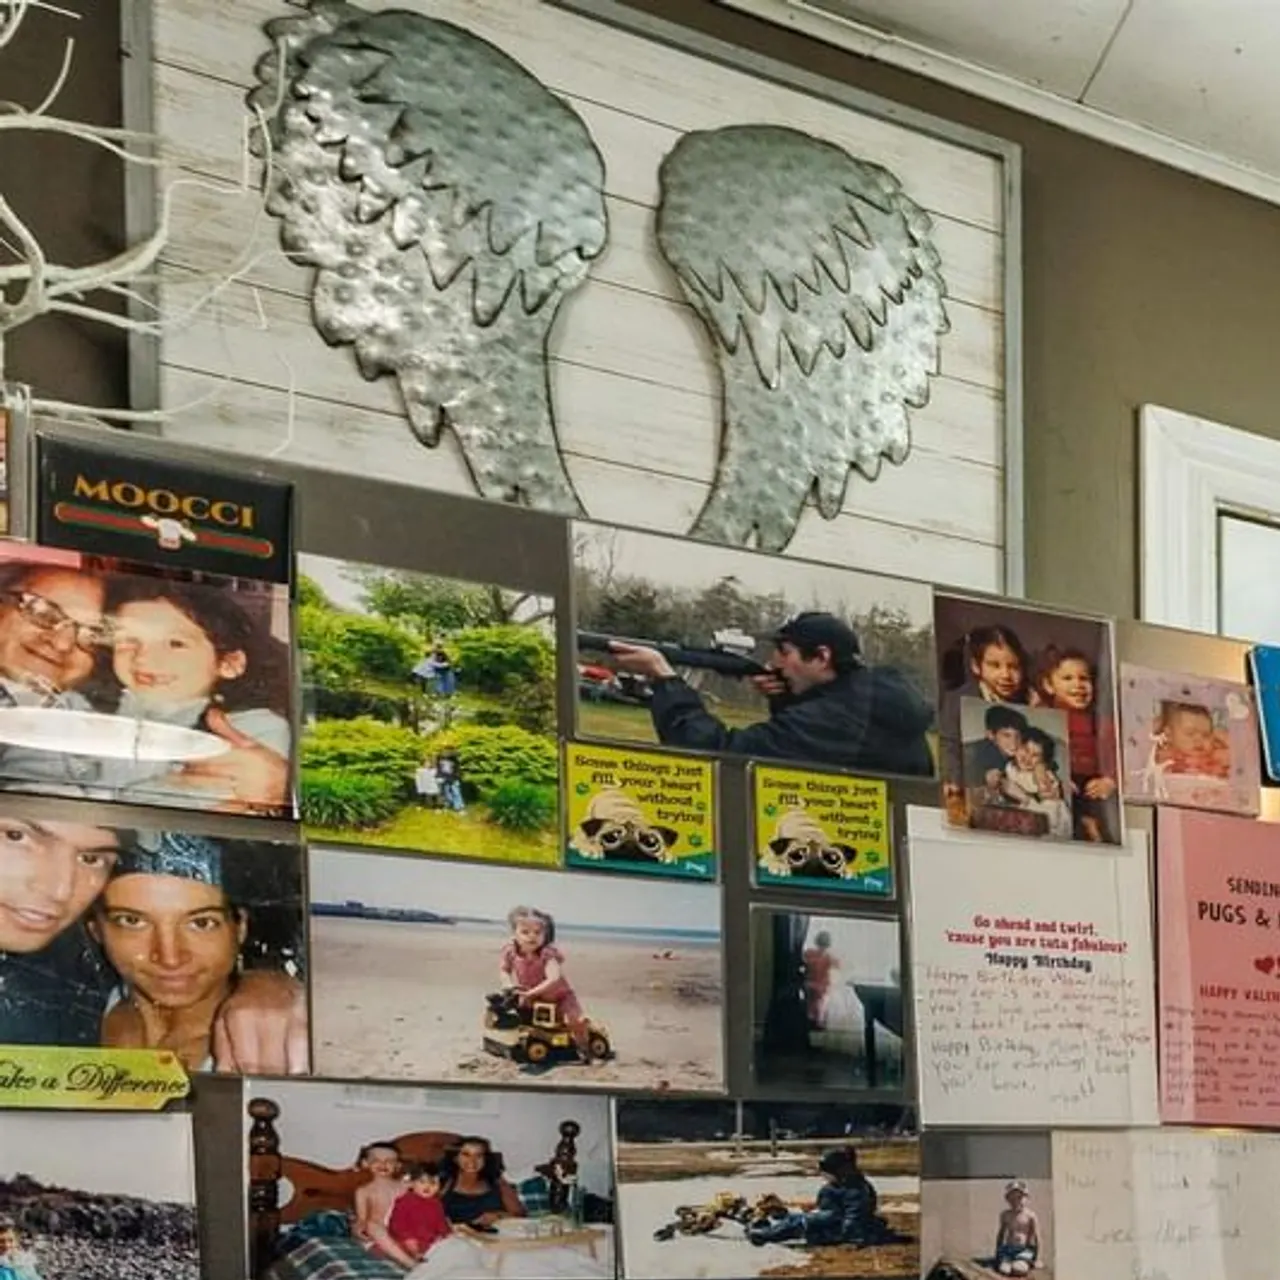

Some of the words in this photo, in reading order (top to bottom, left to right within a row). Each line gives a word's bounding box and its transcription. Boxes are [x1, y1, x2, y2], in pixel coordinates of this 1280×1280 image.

[74, 475, 256, 530] MOOCCI
[575, 754, 618, 768] Some
[622, 759, 671, 775] things
[674, 765, 704, 777] just
[591, 771, 616, 786] fill
[619, 776, 655, 788] your
[660, 777, 701, 792] heart
[763, 777, 801, 789] Some
[806, 780, 850, 794] things
[637, 792, 693, 807] without
[802, 797, 837, 808] your
[840, 798, 878, 811] heart
[656, 808, 705, 825] trying
[819, 812, 870, 824] without
[973, 914, 991, 928] Go
[994, 916, 1031, 931] ahead
[1034, 920, 1057, 933] and
[1198, 900, 1248, 926] PUGS
[1254, 907, 1271, 929] &
[988, 933, 1012, 949] you
[1015, 935, 1036, 948] are
[985, 952, 1029, 970] Happy
[1033, 954, 1092, 973] Birthday
[1200, 984, 1238, 1001] HAPPY
[0, 1059, 37, 1091] ake
[41, 1077, 59, 1090] a
[66, 1063, 188, 1100] Difference
